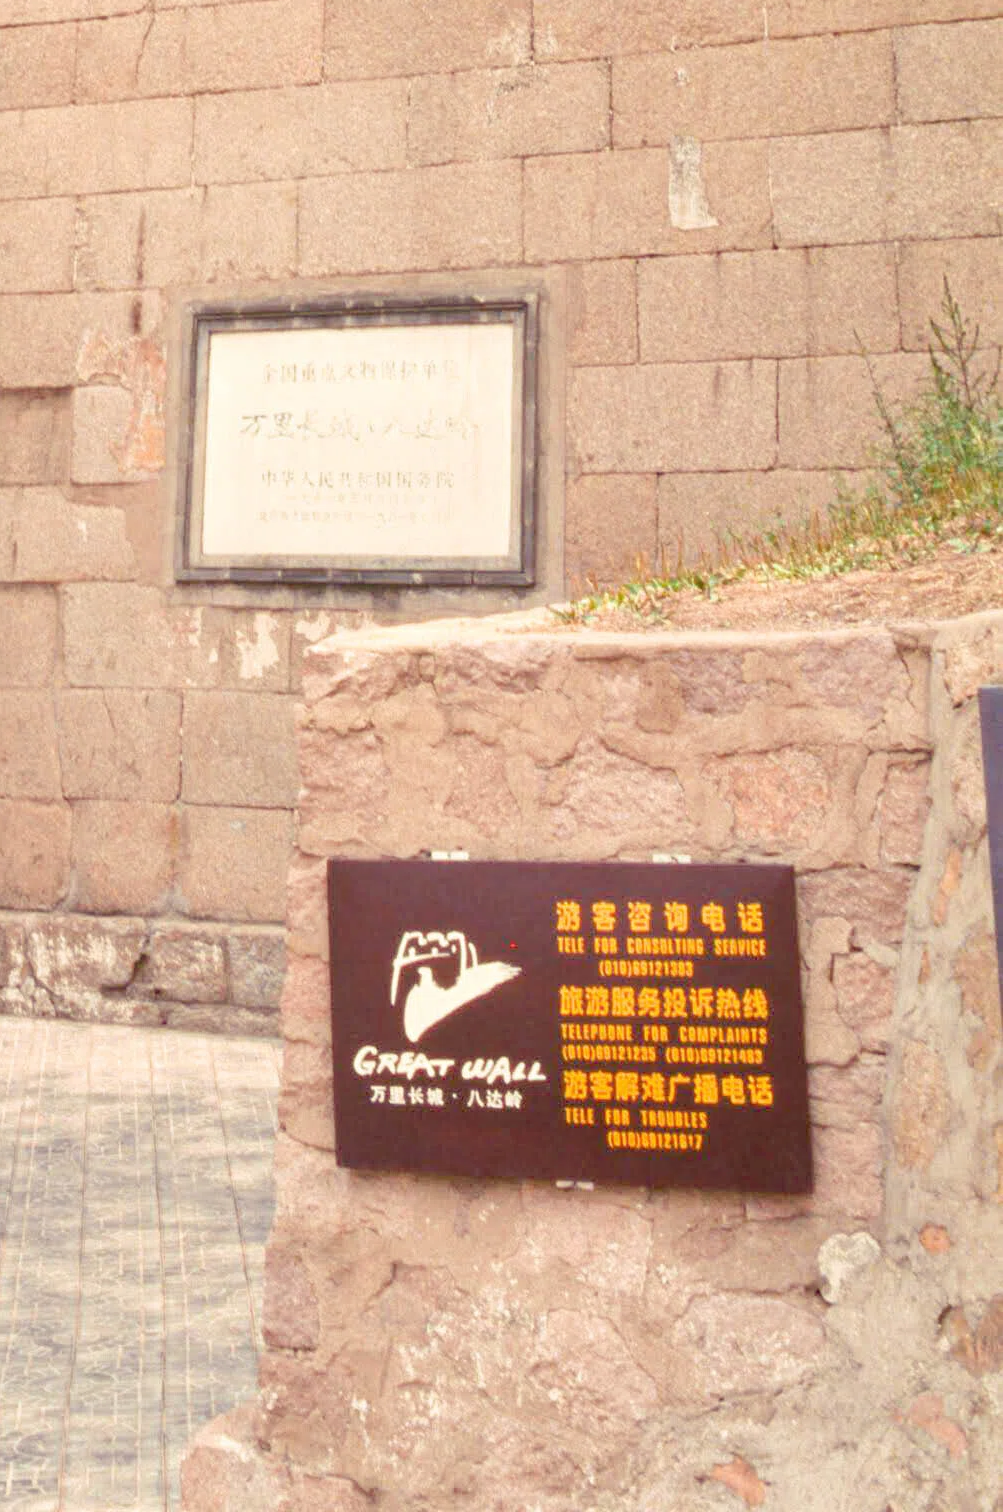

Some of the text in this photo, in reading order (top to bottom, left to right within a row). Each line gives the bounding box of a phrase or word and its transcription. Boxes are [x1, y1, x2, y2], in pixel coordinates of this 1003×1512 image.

[261, 469, 455, 489] 中华人民共和国国务院
[556, 900, 763, 933] 游客咨询电话
[557, 936, 766, 957] TELE FOR CONSULTING SERVICE
[559, 984, 768, 1019] 旅游服务投诉热线
[561, 1023, 767, 1045] TELEPHONE FOR COMPLAINTS
[353, 1045, 547, 1085] GREAT WALL
[563, 1069, 774, 1106] 游客解难广播电话
[565, 1107, 708, 1129] TELE FOR TROUBLES
